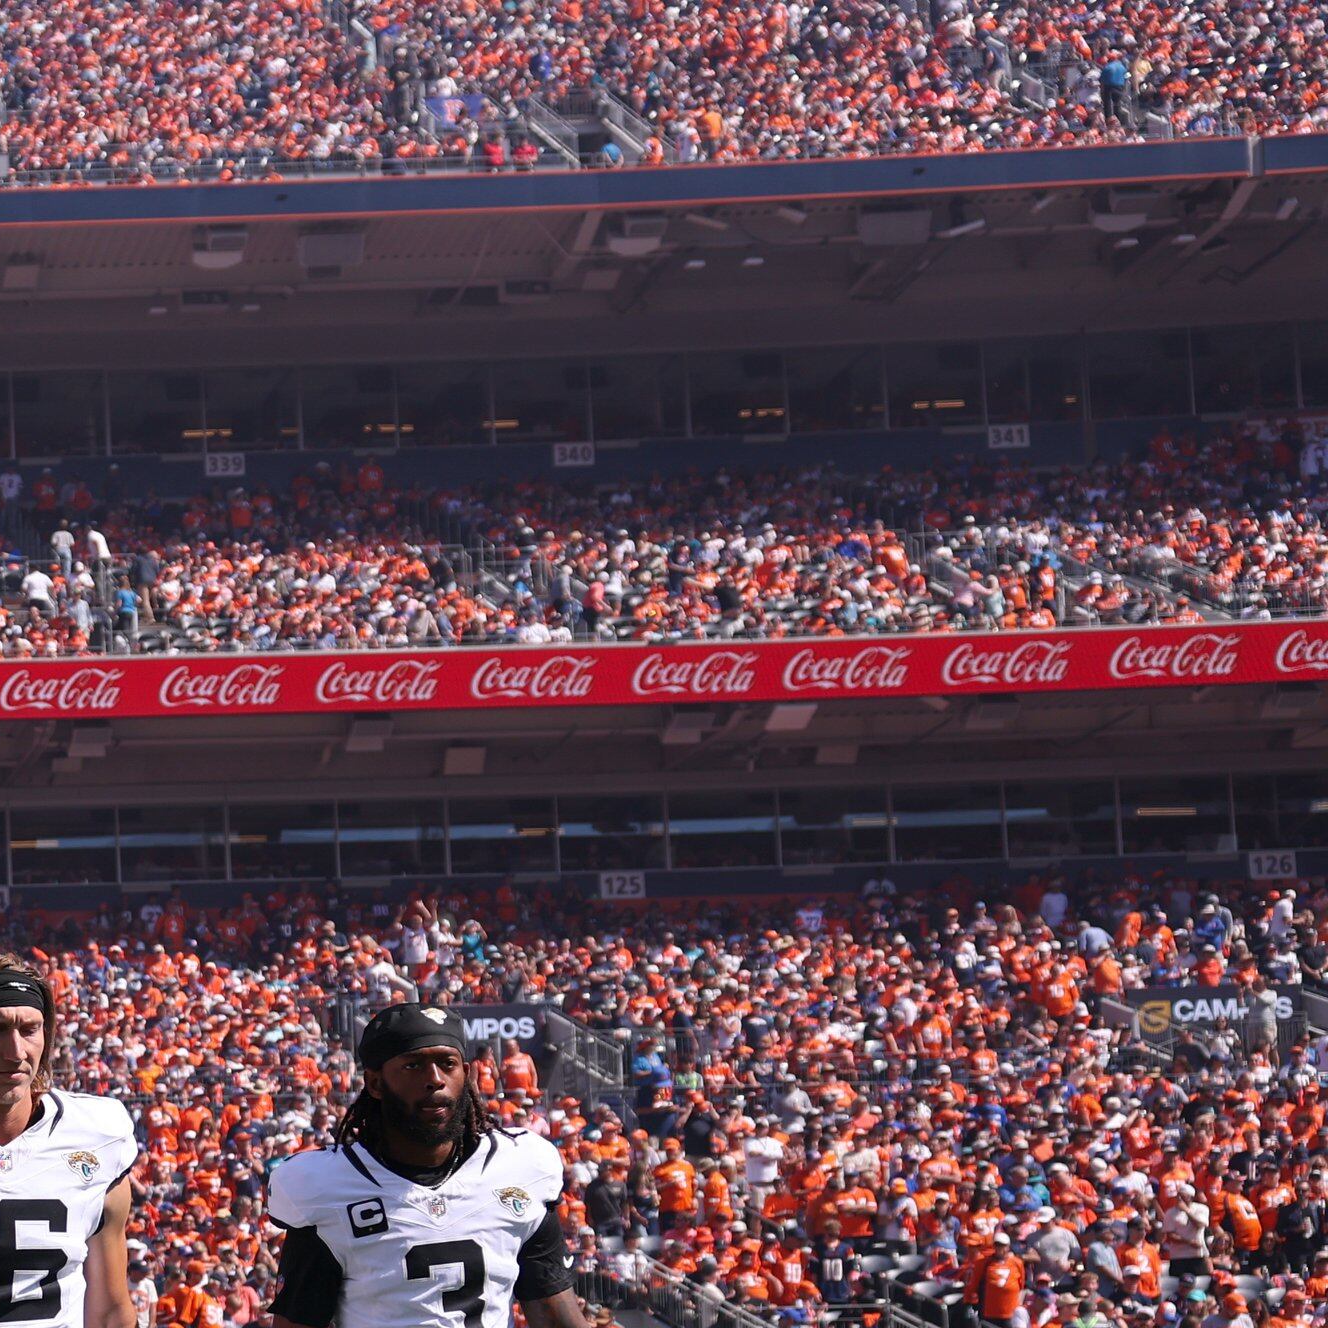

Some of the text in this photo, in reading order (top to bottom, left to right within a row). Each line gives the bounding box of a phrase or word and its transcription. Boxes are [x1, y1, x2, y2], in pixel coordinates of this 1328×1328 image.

[992, 427, 1024, 445] 341
[208, 455, 242, 473] 339
[559, 446, 593, 463] 340
[1254, 854, 1293, 874] 126
[604, 876, 641, 895] 125
[1172, 996, 1294, 1022] CAMS
[351, 1200, 384, 1229] C
[822, 1258, 843, 1281] 10
[995, 1268, 1011, 1288] 7
